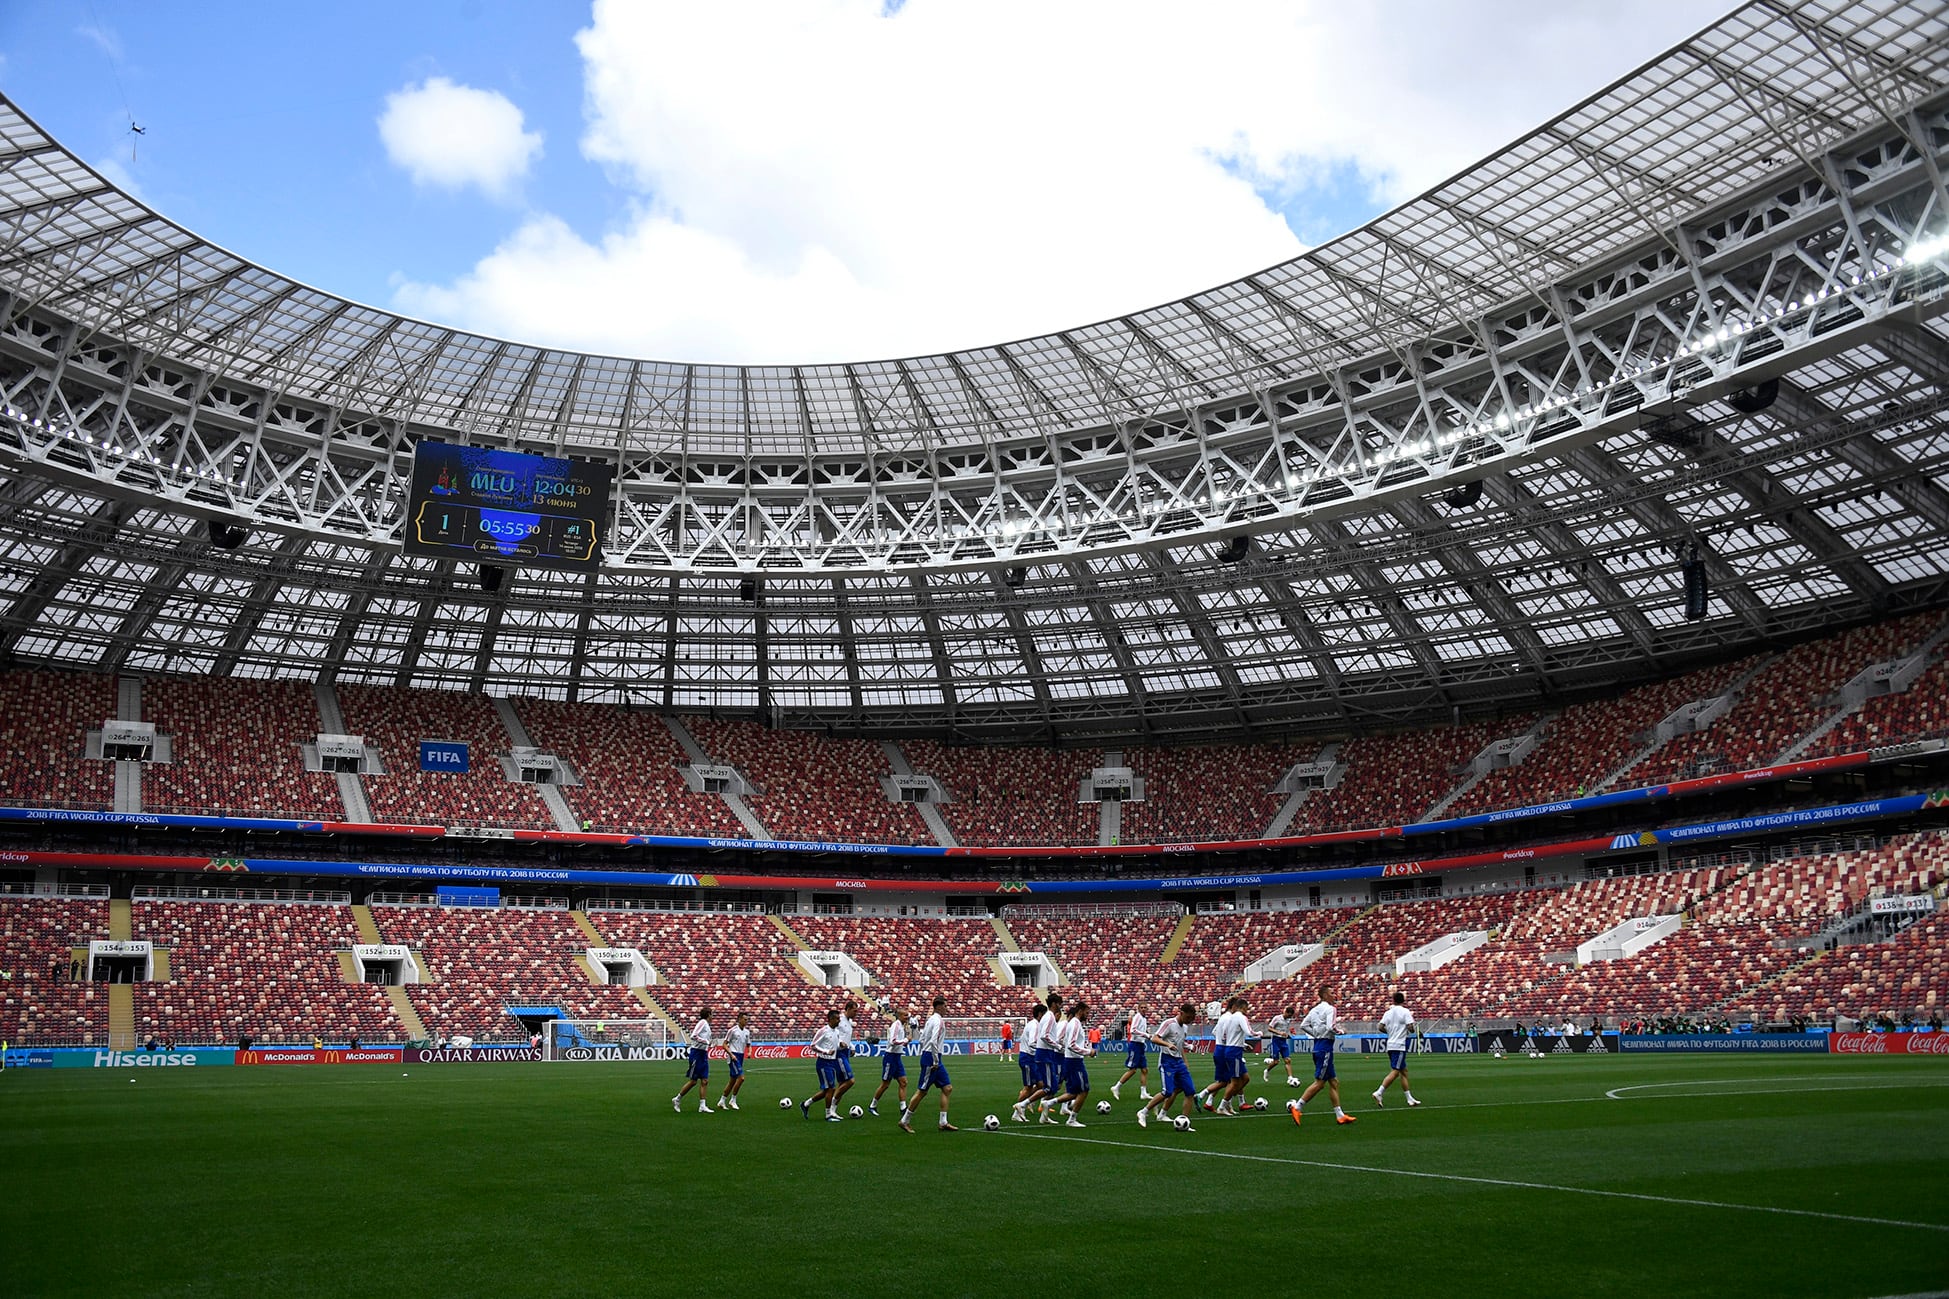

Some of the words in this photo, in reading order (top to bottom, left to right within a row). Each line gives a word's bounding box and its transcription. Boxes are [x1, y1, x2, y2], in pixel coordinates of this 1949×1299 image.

[470, 472, 515, 492] MLU
[533, 494, 544, 504] 13
[441, 514, 448, 530] 1
[428, 750, 461, 763] FIFA
[1514, 808, 1536, 817] WORLD
[1536, 806, 1549, 814] CUP
[1549, 802, 1572, 812] RUSSIA
[50, 812, 69, 820] FIFA
[69, 813, 104, 821] WORLD
[104, 814, 124, 822] CUP
[125, 815, 160, 824] RUSSIA
[1670, 825, 1715, 837] ЧЕМПИОНАТ
[1716, 822, 1740, 832] МИРА
[1741, 820, 1753, 828] ПО
[1754, 815, 1793, 826] ФУТБОЛУ
[1794, 812, 1812, 822] FIFA
[1813, 809, 1833, 819] 2018
[1834, 808, 1841, 816] В
[1842, 803, 1880, 815] РОССИИ
[708, 840, 754, 848] ЧЕМПИОНАТ
[789, 843, 820, 851] ФУТБОЛУ
[1503, 850, 1534, 859] #worldcup
[358, 865, 410, 874] ЧЕМПИОНАТ
[451, 868, 489, 877] ФУТБОЛУ
[491, 869, 508, 877] FIFA
[510, 870, 528, 878] 2018
[535, 871, 568, 879] РОССИИ
[1161, 880, 1177, 888] 2018
[1193, 878, 1219, 886] WORLD
[1235, 876, 1261, 884] RUSSIA
[905, 1043, 962, 1056] WDA
[1103, 1041, 1124, 1052] vivo
[1366, 1039, 1388, 1053] VIS
[1443, 1038, 1473, 1053] VISA
[1622, 1040, 1665, 1048] ЧЕМПИОНАТ
[1667, 1040, 1689, 1048] МИРА
[1691, 1040, 1702, 1048] ПО
[1703, 1040, 1740, 1048] ФУТБОЛУ
[1741, 1040, 1759, 1048] FIFA
[1760, 1040, 1779, 1048] 2018
[1788, 1040, 1824, 1048] РОССИИ
[1836, 1033, 1888, 1053] Coca-Cola
[1906, 1033, 1949, 1053] Coca-Co
[264, 1053, 315, 1061] McDonald's
[345, 1052, 395, 1060] McDonald's
[420, 1049, 473, 1063] QATAR
[476, 1048, 542, 1061] AIRWAYS
[570, 1050, 588, 1058] KIA
[595, 1048, 623, 1060] KIA
[754, 1046, 789, 1058] Coca-Cola
[94, 1051, 196, 1067] Hisense
